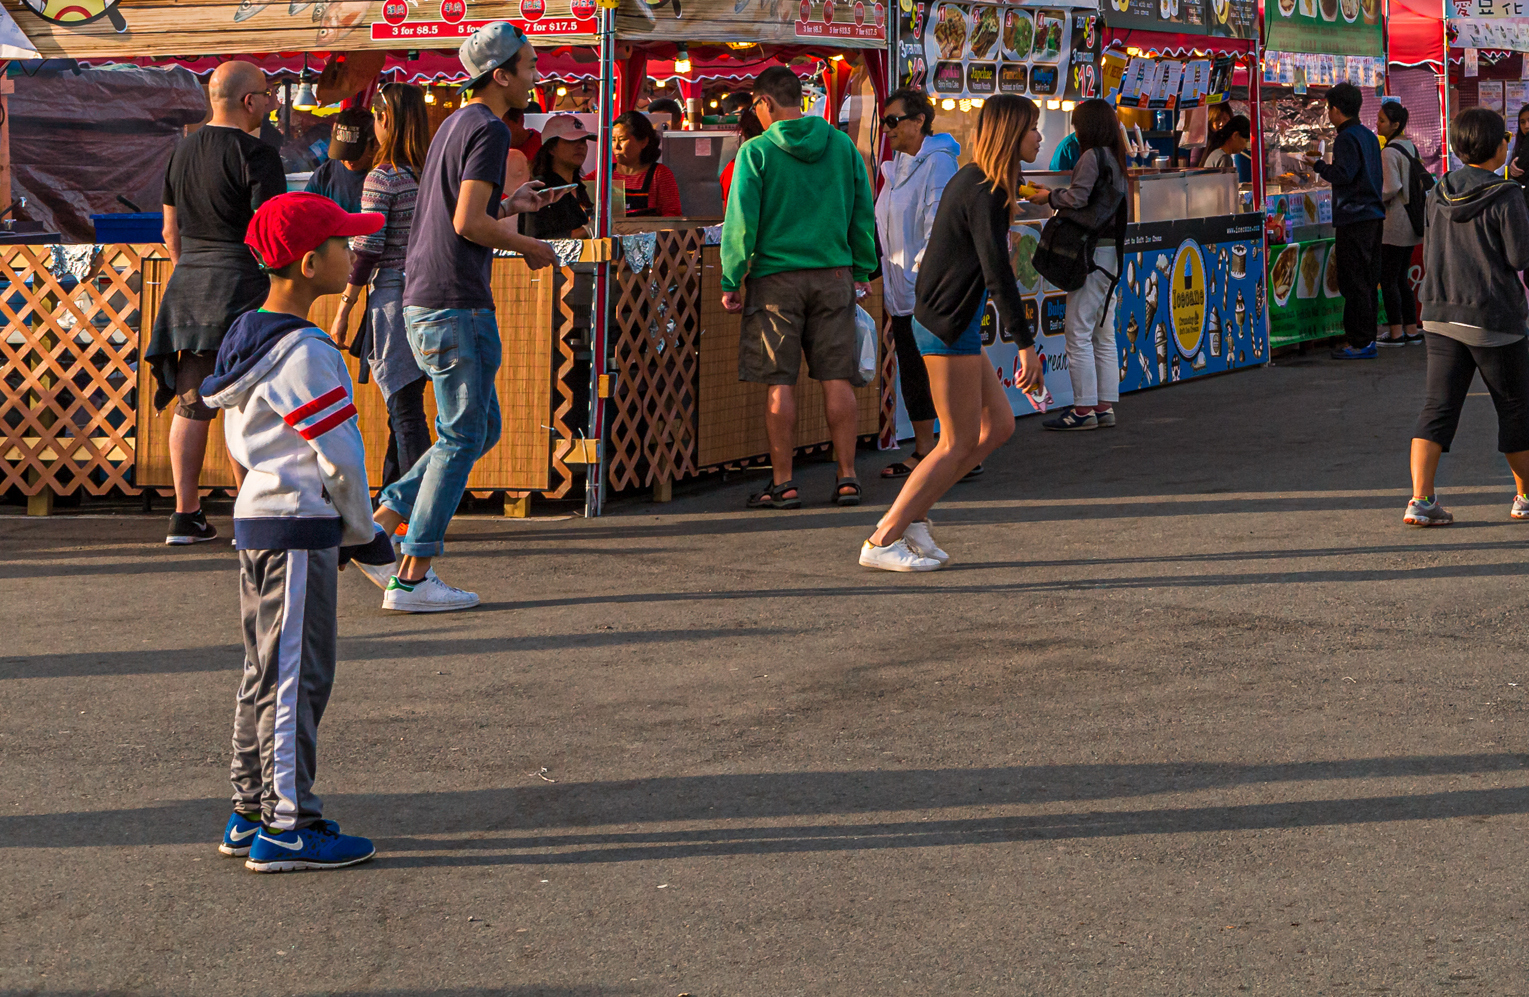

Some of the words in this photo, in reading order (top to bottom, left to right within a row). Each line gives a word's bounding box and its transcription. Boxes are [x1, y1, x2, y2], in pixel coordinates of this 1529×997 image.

[910, 2, 925, 39] $5
[974, 10, 980, 23] 2
[1007, 13, 1012, 26] 3
[400, 26, 414, 35] for
[416, 25, 438, 35] $8.5
[524, 24, 531, 32] 7
[533, 23, 547, 32] for
[549, 21, 577, 32] $17.5
[1084, 16, 1096, 48] $5
[970, 67, 992, 80] Japchae
[1003, 68, 1024, 80] Pancake
[1074, 64, 1095, 98] $12
[1173, 288, 1204, 310] Icecane
